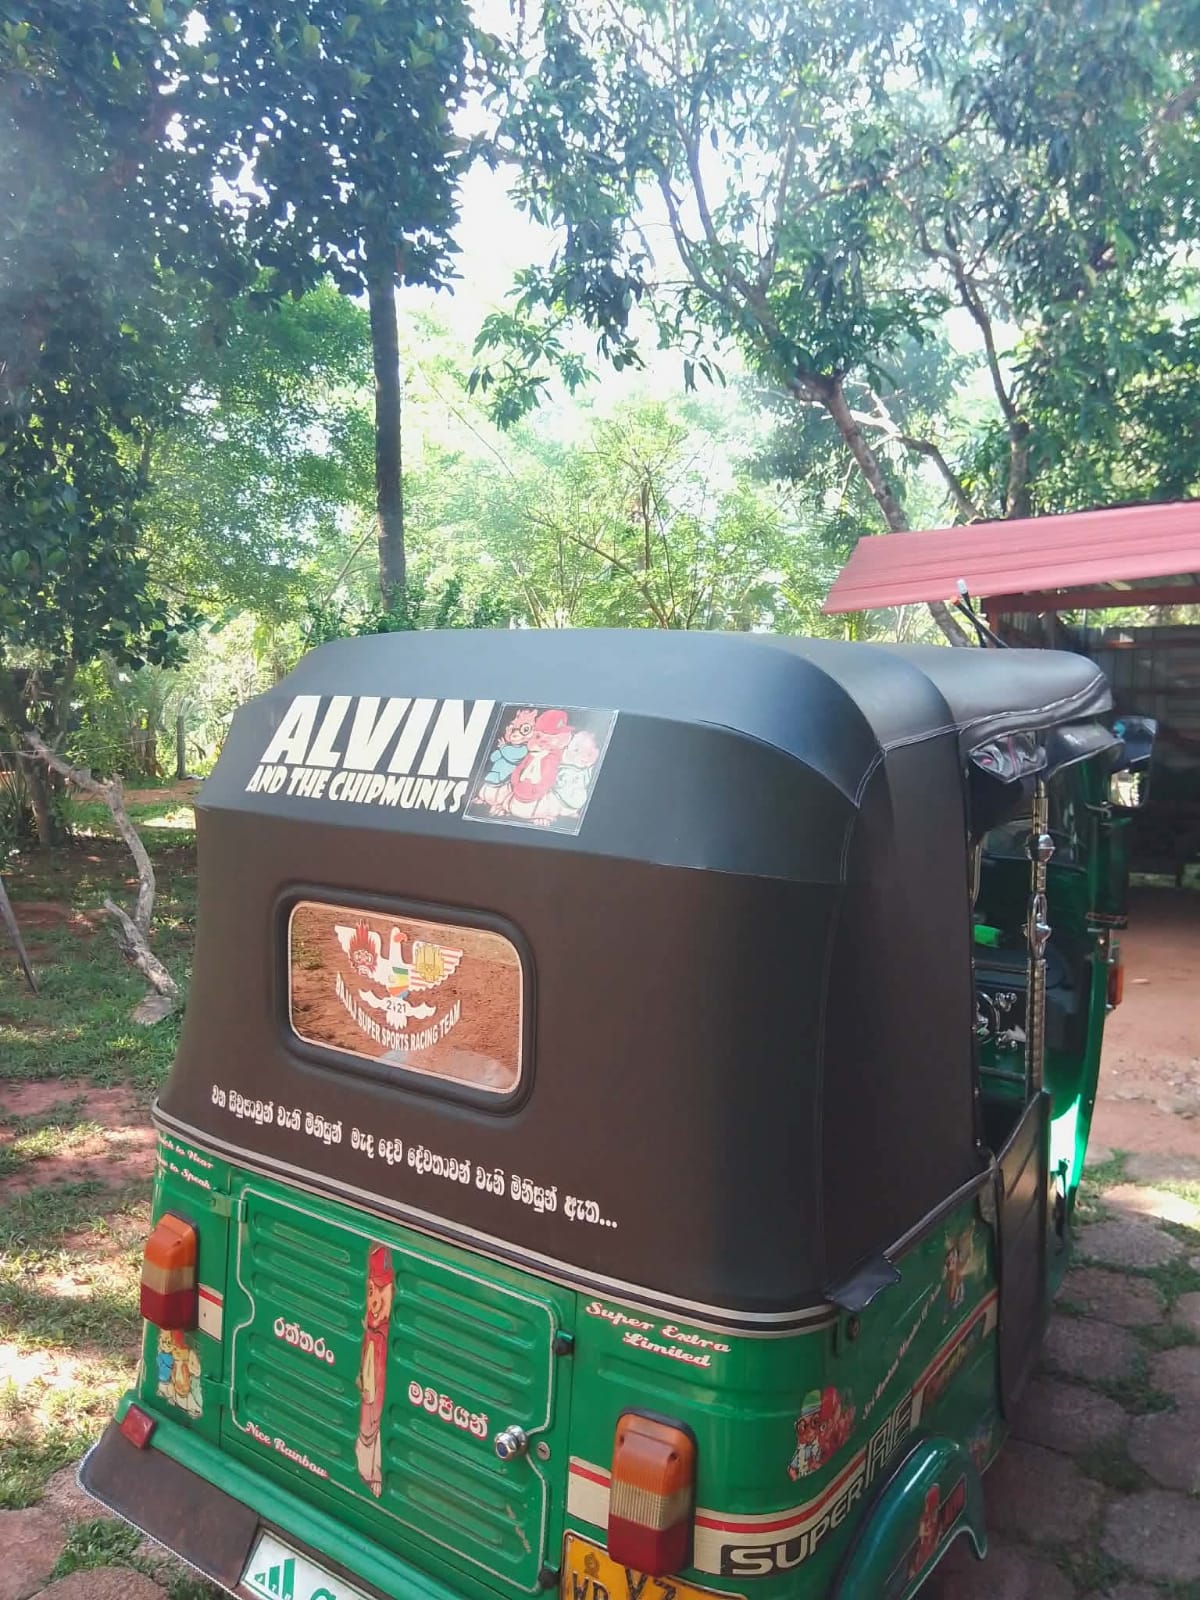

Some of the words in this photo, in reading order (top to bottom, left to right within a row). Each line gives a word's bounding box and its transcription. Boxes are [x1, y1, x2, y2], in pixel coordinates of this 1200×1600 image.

[260, 695, 496, 778] ALVIN
[245, 765, 287, 795] AND
[286, 769, 326, 800] THE
[328, 771, 469, 814] CHIPMUNKS
[520, 756, 542, 784] A
[335, 971, 357, 1020] BAJAJ
[358, 1009, 381, 1044] SUPER
[381, 1030, 409, 1051] SPORTS
[410, 1026, 438, 1051] RACING
[439, 1000, 461, 1038] TEAM
[585, 1301, 654, 1331] Super
[660, 1325, 731, 1353] Extra
[622, 1331, 712, 1369] Limited
[246, 1421, 271, 1448] Nice
[274, 1438, 329, 1480] Rainbow
[729, 1475, 864, 1576] SUPER
